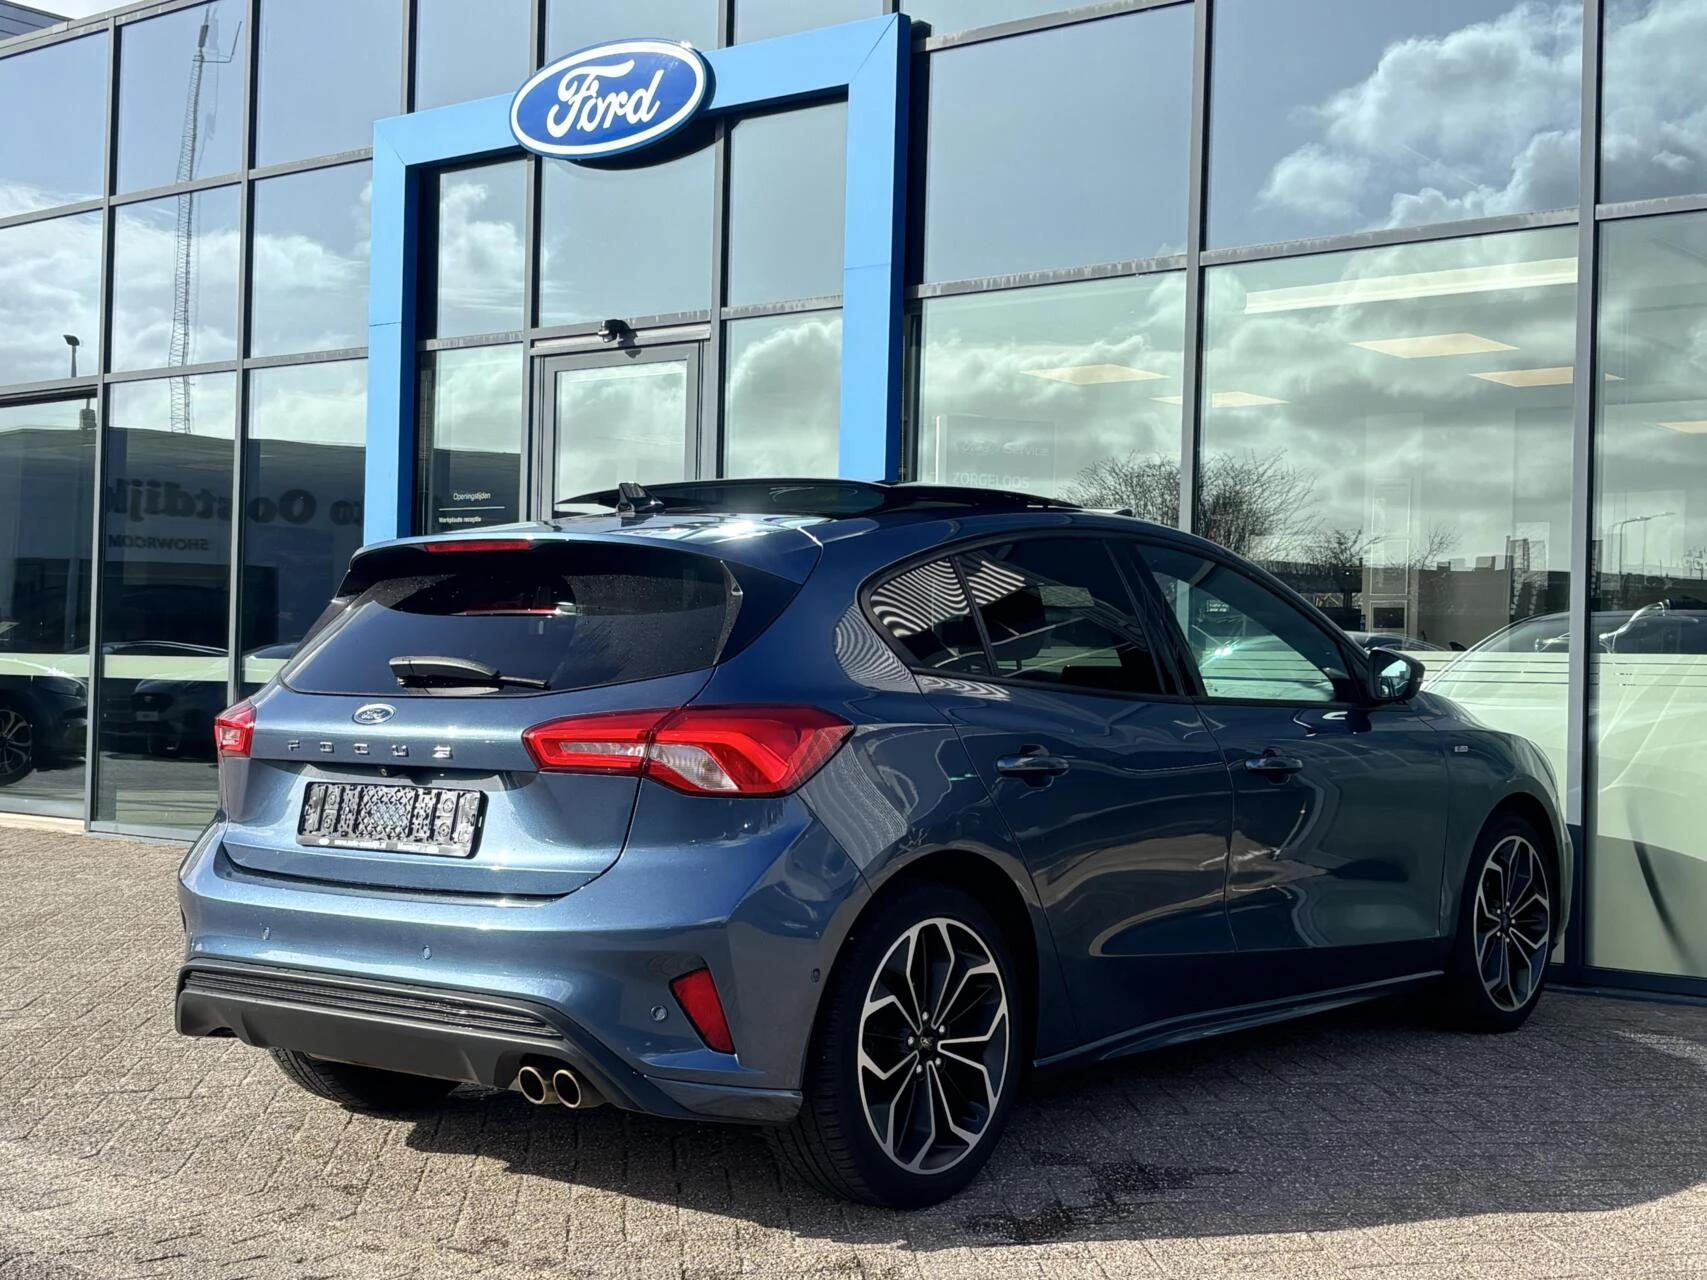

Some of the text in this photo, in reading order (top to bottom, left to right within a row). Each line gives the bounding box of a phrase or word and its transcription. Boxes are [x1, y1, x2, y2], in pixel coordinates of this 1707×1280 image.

[547, 59, 664, 138] Ford
[952, 472, 1030, 490] ZORGELOOS
[287, 739, 452, 760] FOCUS
